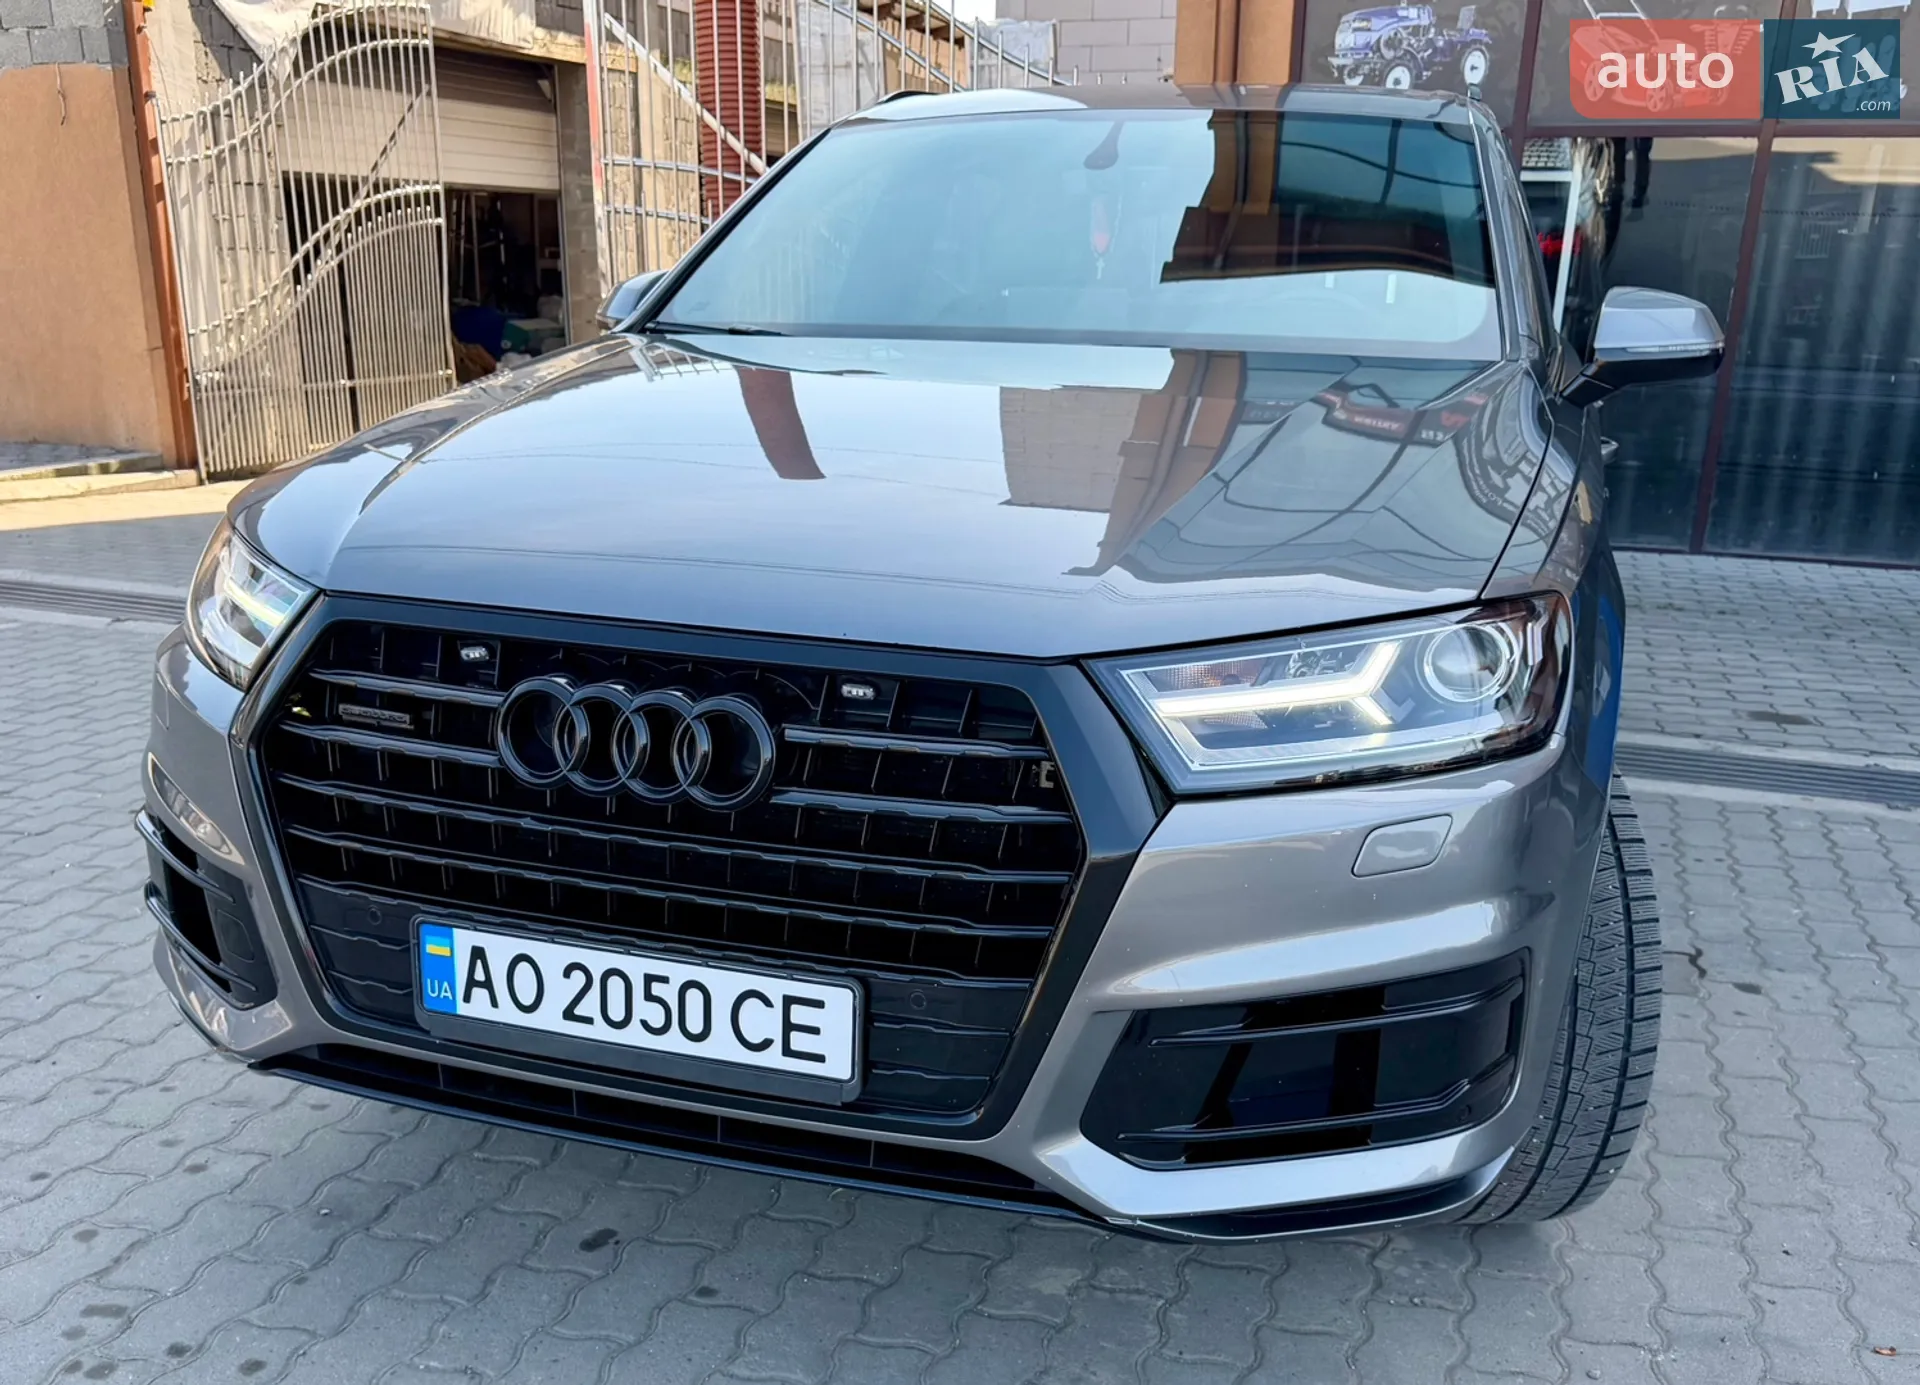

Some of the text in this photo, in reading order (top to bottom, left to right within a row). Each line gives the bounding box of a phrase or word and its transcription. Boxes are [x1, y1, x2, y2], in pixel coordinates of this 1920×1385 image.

[427, 978, 454, 1001] UA
[462, 944, 827, 1064] AO 2050 CE
